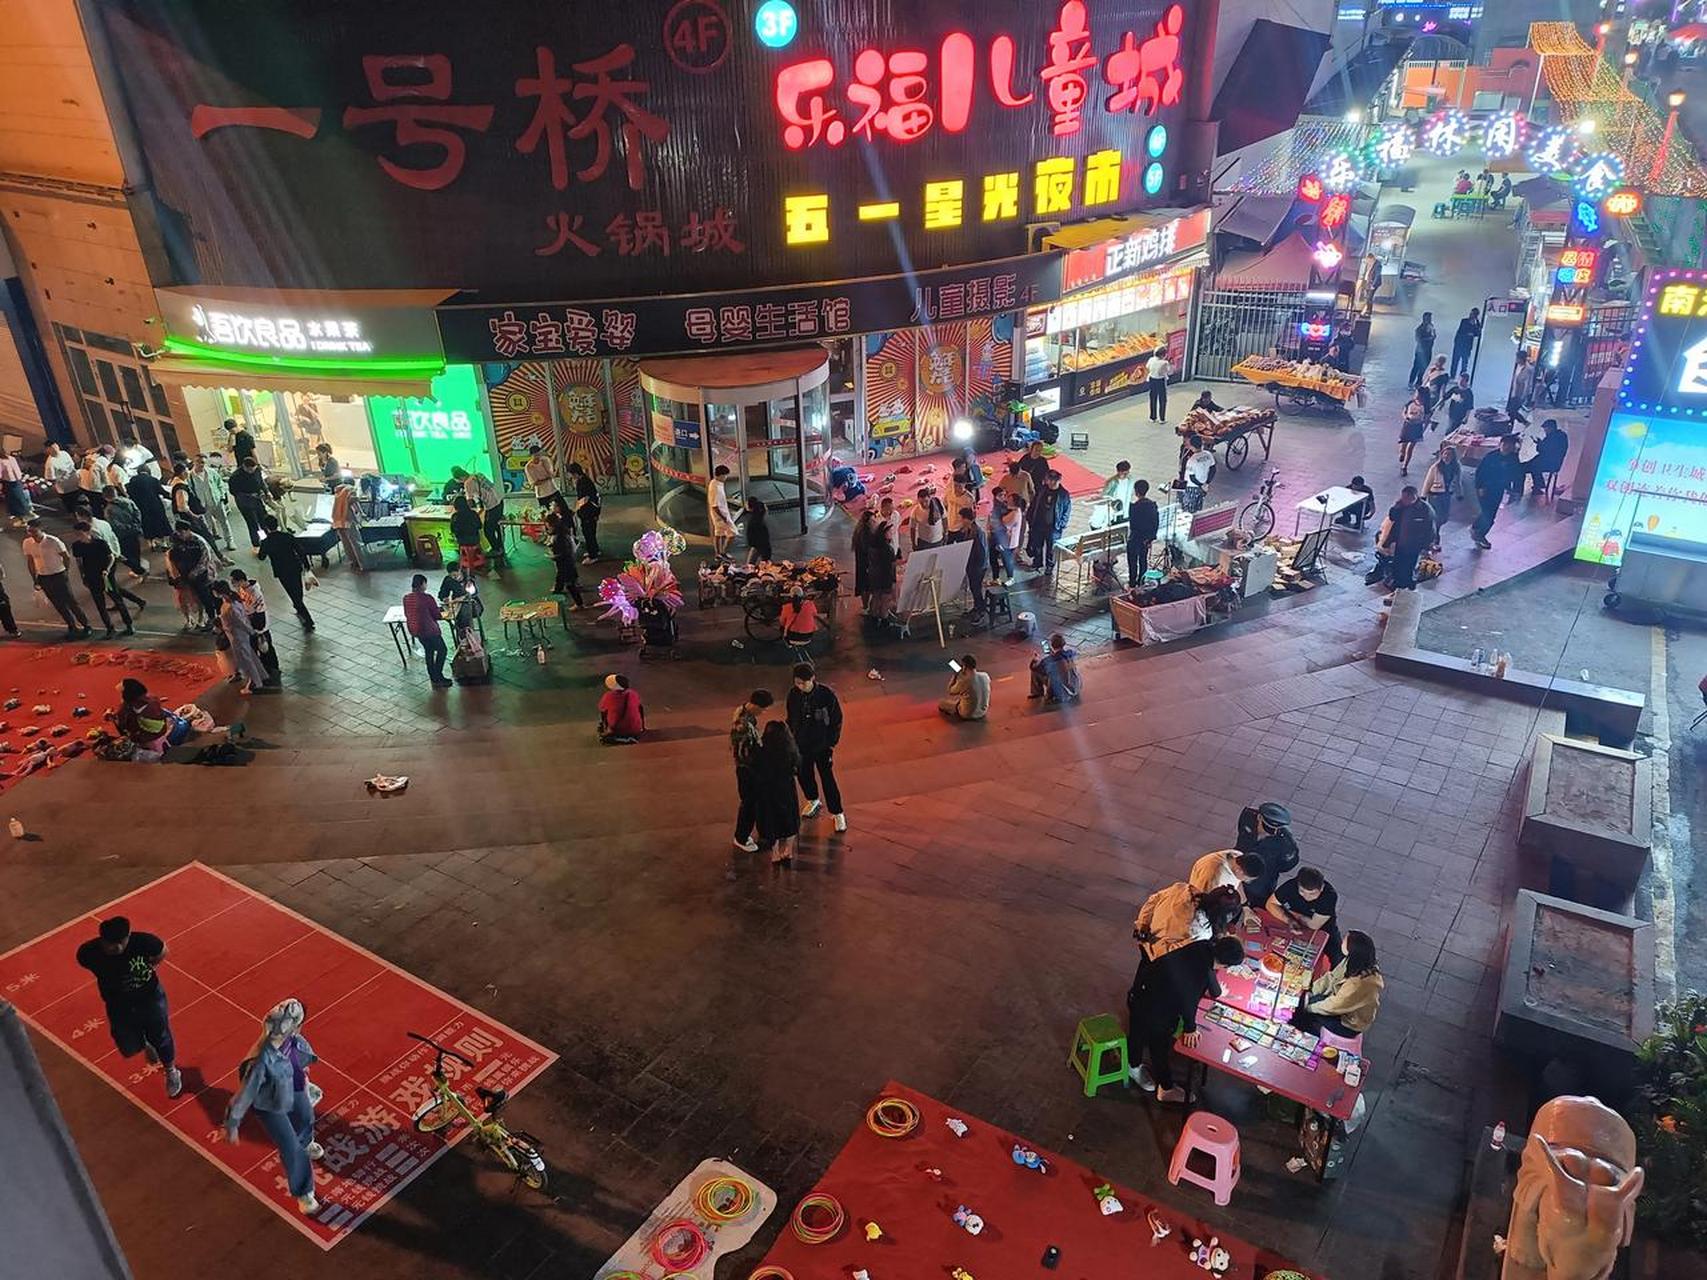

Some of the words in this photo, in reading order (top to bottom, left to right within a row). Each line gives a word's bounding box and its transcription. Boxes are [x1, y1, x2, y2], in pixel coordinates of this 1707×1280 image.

[672, 15, 721, 54] 4F
[761, 9, 794, 38] 3F
[776, 0, 1184, 149] 乐福儿童城
[192, 43, 670, 190] 一号桥
[1329, 113, 1618, 192] 乐福休闲美食
[784, 148, 1123, 246] 五一星光夜市
[534, 207, 747, 258] 火锅城
[1106, 220, 1180, 275] 正新鸡排
[489, 307, 637, 356] 家宝爱婴
[684, 297, 852, 344] 母婴生活馆
[910, 273, 1017, 322] 儿童摄影
[1660, 285, 1707, 316] 南
[6, 972, 41, 993] 5米
[72, 1017, 105, 1041] 4米
[128, 1061, 164, 1084] 3米
